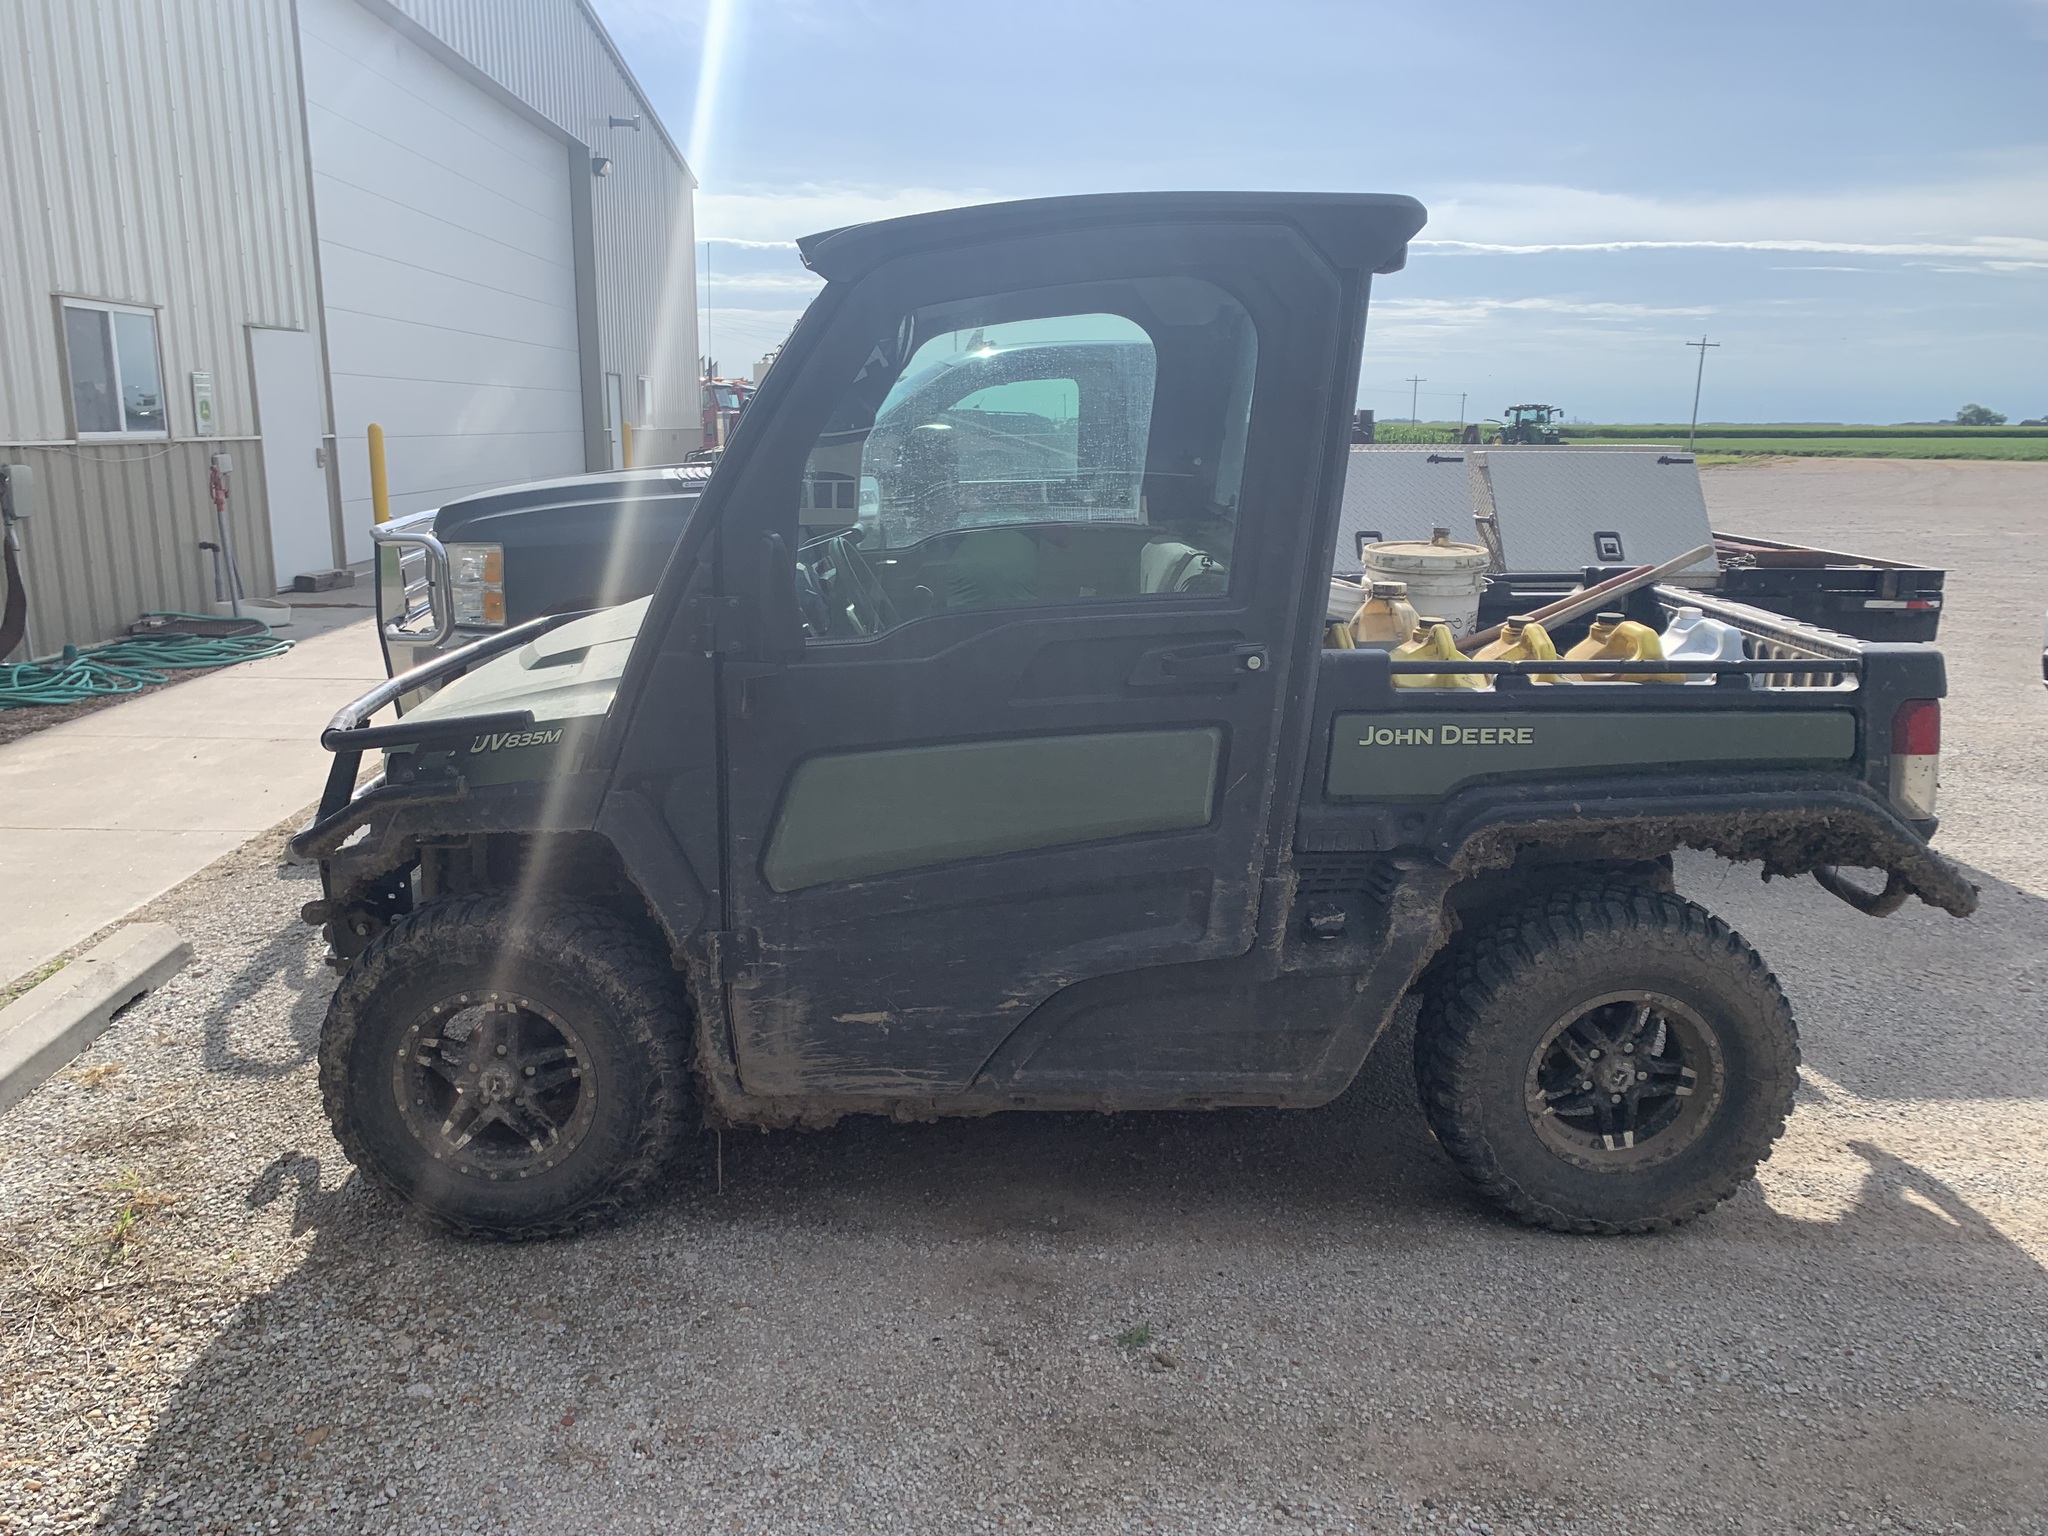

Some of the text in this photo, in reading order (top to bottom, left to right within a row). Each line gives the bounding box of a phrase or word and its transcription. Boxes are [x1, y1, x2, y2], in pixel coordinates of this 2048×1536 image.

[470, 729, 564, 753] UV835M
[1359, 725, 1534, 746] JOHN DEERE
